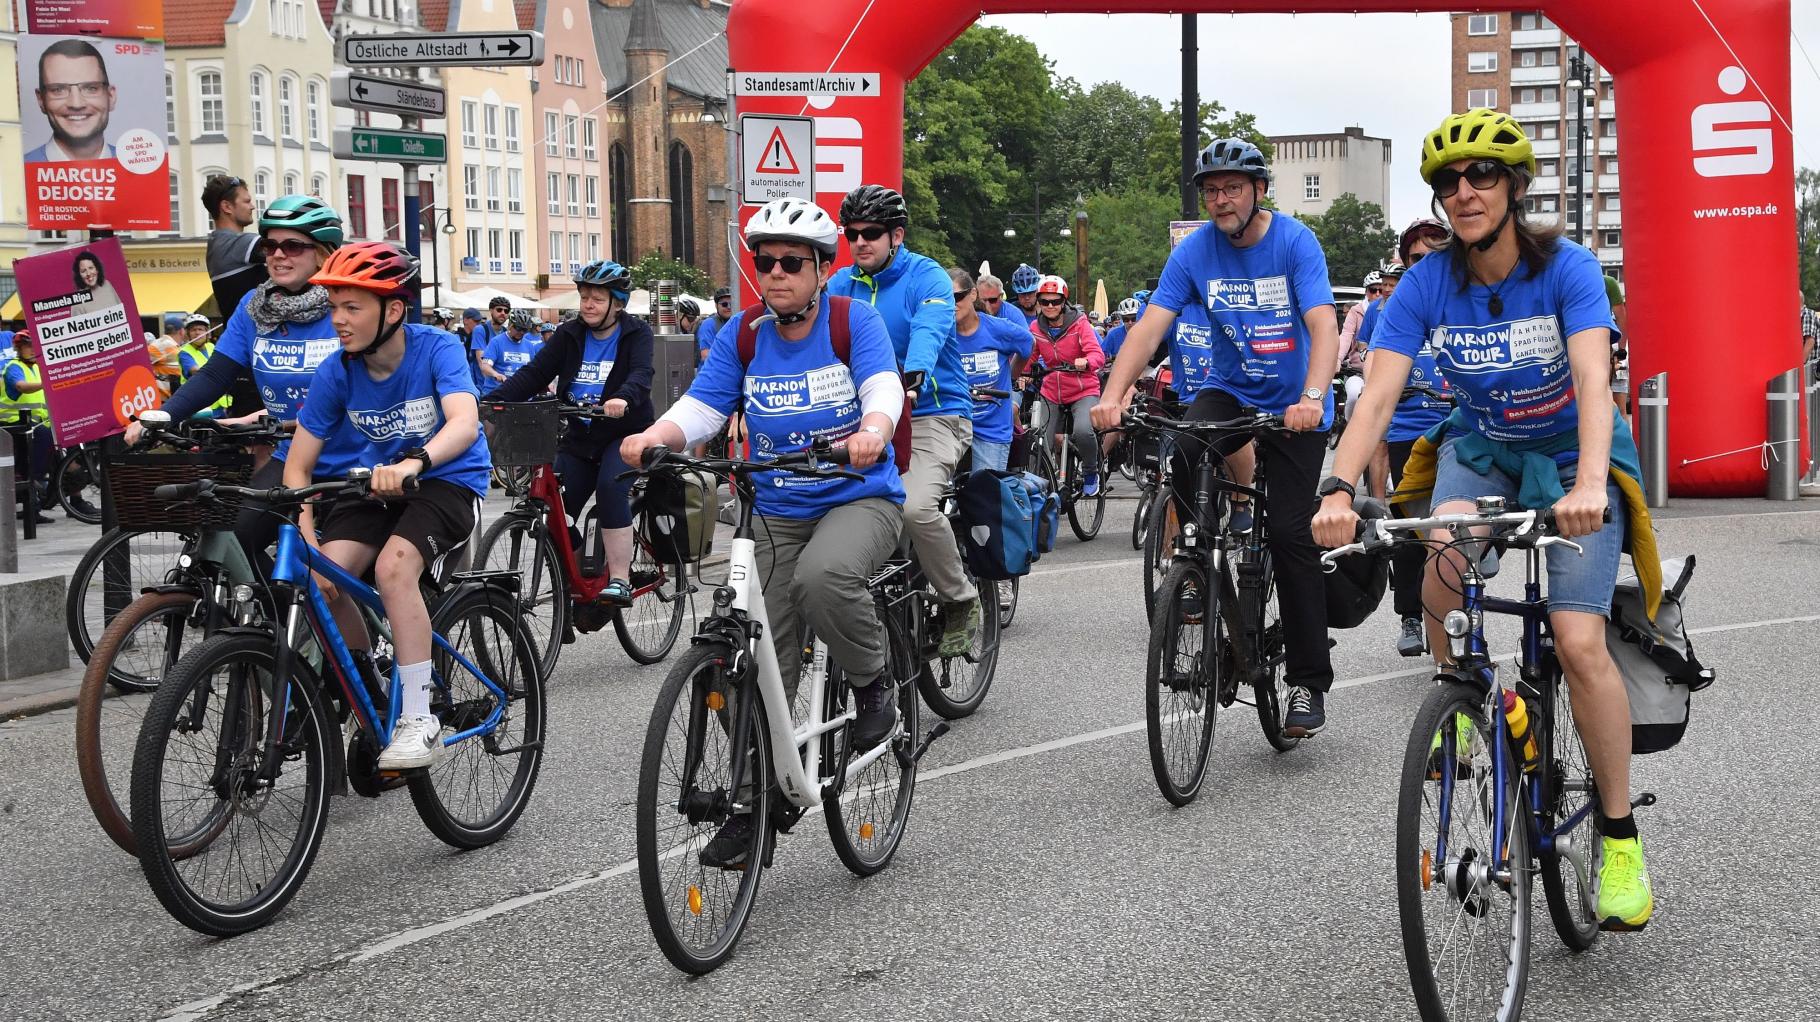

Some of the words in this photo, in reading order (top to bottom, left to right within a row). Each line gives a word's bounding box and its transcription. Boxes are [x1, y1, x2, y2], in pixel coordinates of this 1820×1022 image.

[115, 44, 140, 54] SPD
[355, 43, 408, 58] Östliche
[416, 42, 468, 56] Altstadt
[745, 78, 856, 92] Standesamt/Archiv
[396, 90, 436, 109] Ständehaus
[126, 142, 153, 150] 09.06.24
[402, 140, 425, 154] Toilette
[128, 156, 157, 164] WÄHLEN!
[37, 168, 116, 183] MARCUS
[750, 178, 805, 188] automatischer
[38, 186, 116, 201] DEJOSEZ
[766, 189, 789, 198] Poller
[1694, 202, 1778, 218] www.ospa.de
[150, 260, 156, 268] &
[1217, 283, 1255, 294] WARNOW
[34, 296, 72, 312] Manuela
[72, 292, 92, 304] Ripa
[1228, 294, 1254, 304] TOUR
[42, 324, 65, 340] Der
[66, 316, 102, 331] Natur
[104, 310, 124, 324] eine
[46, 342, 95, 361] Stimme
[96, 328, 130, 352] geben!
[1444, 329, 1509, 347] WARNOW
[272, 356, 299, 366] TOUR
[1460, 347, 1505, 362] TOUR
[752, 378, 806, 394] WARNOW
[120, 386, 156, 418] ödp
[767, 394, 804, 406] TOUR
[357, 408, 406, 426] WARNOW
[836, 404, 858, 418] 2024
[372, 419, 406, 436] TOUR
